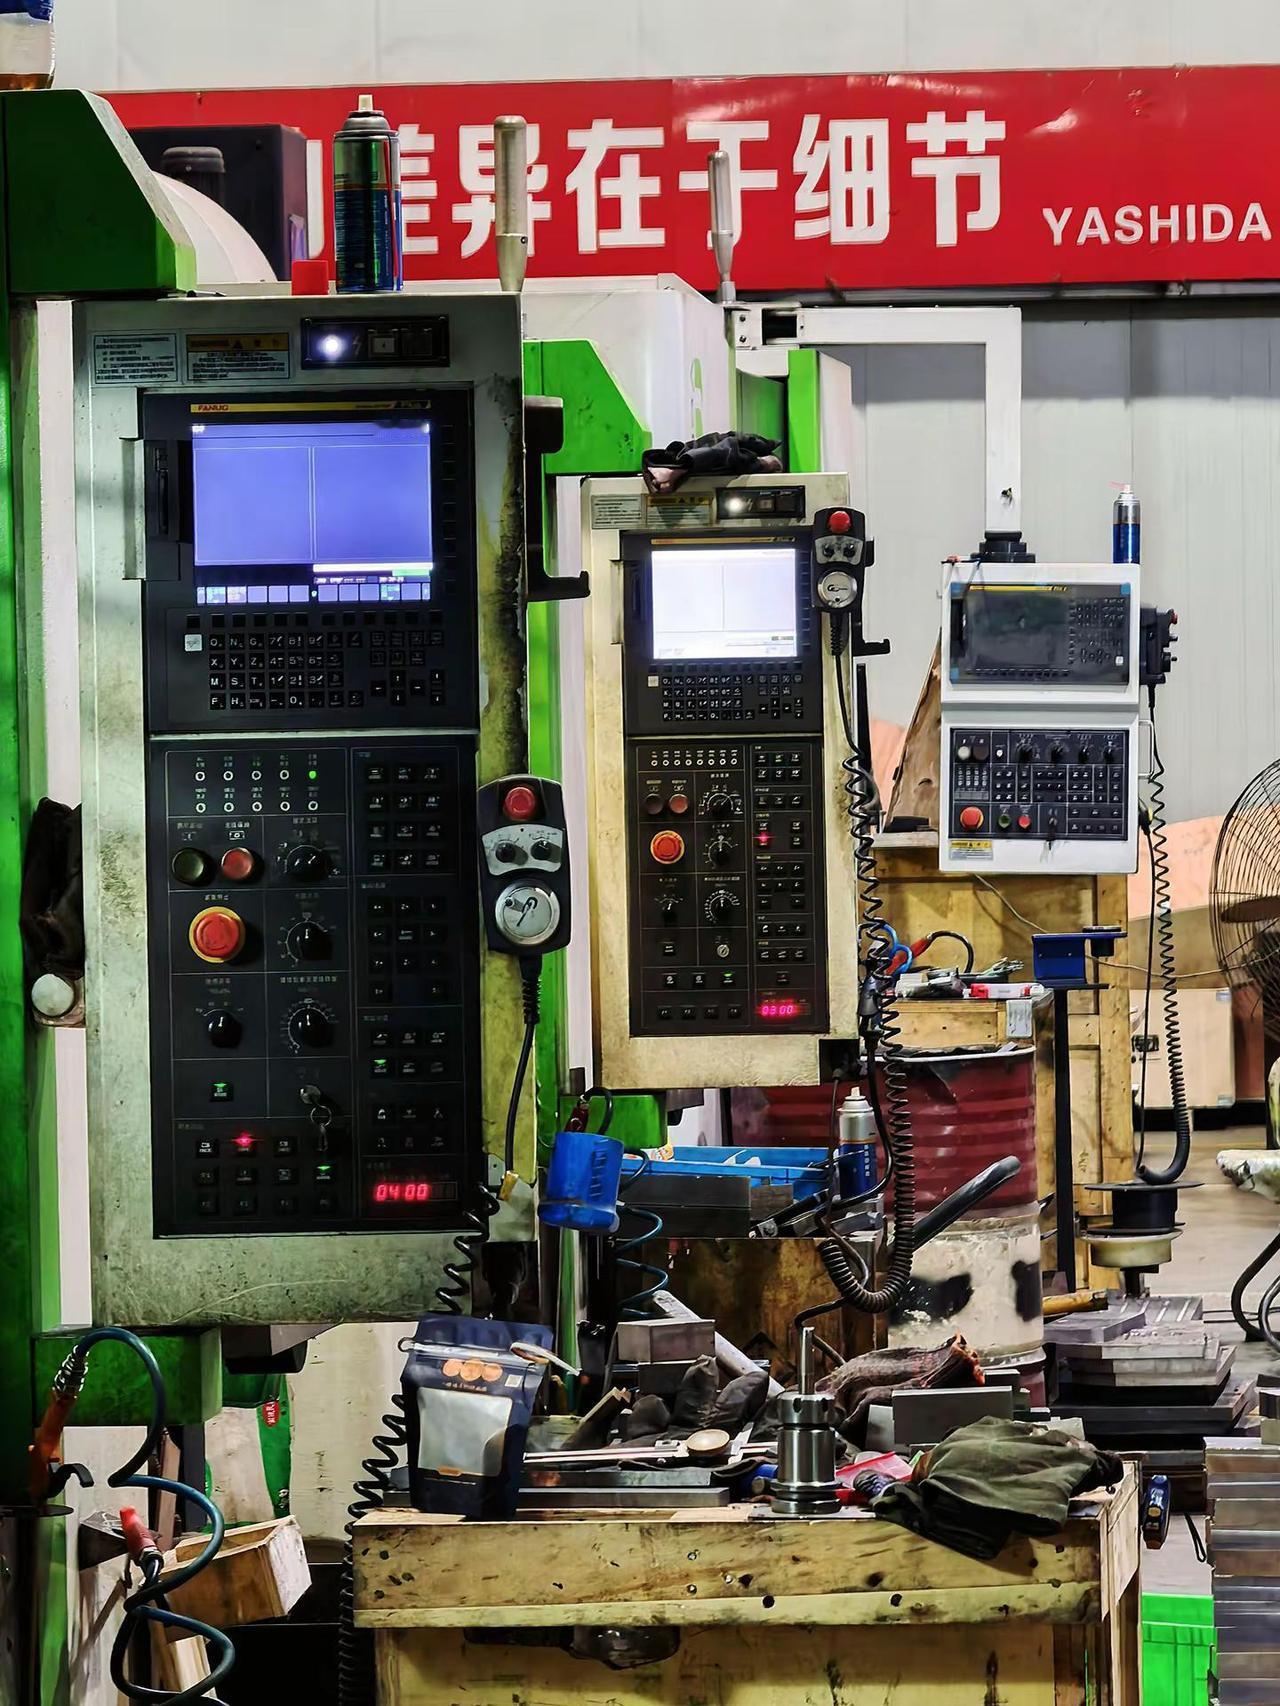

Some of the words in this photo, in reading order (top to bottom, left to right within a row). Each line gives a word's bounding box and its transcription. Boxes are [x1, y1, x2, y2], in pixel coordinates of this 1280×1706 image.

[307, 110, 1006, 259] 异在于细节
[1042, 202, 1272, 246] YASHIDA
